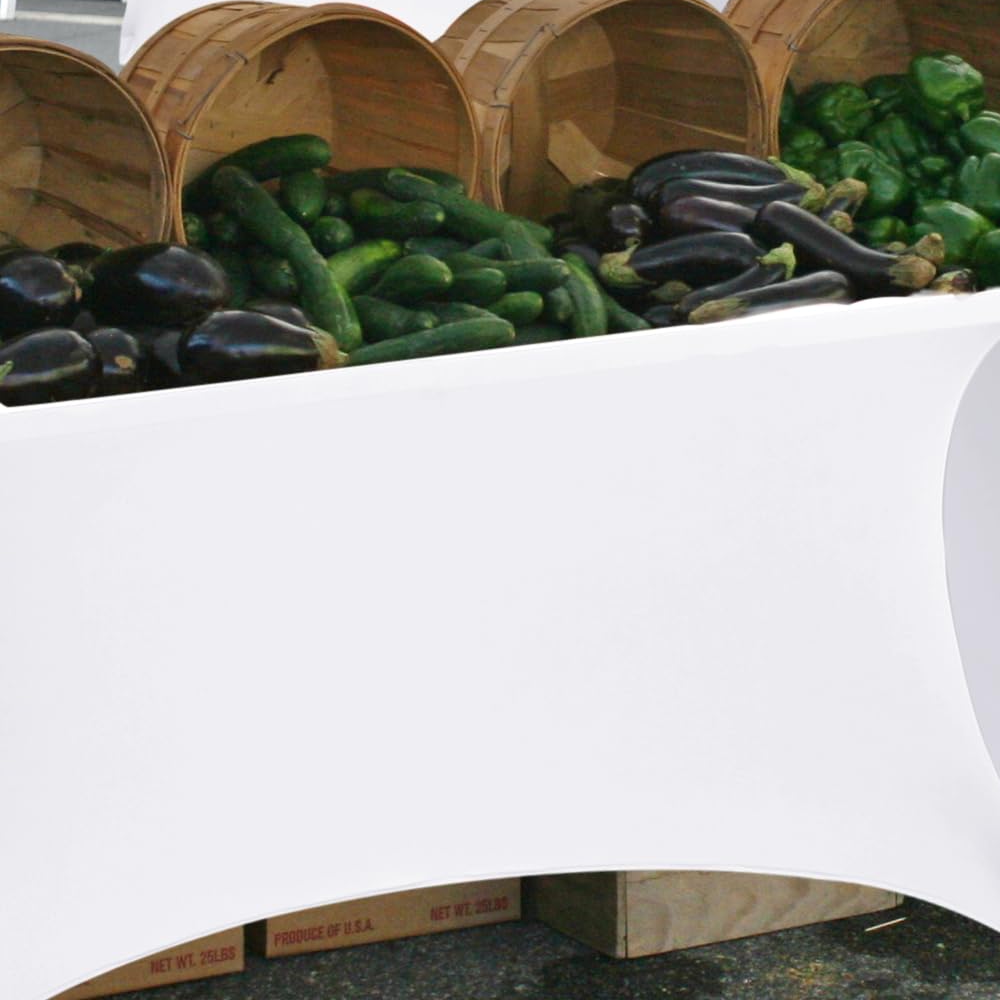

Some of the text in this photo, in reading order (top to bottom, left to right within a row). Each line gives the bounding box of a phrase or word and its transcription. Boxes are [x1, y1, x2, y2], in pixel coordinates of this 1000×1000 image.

[431, 904, 450, 921] NET
[273, 926, 324, 947] PRODUCE
[327, 922, 342, 938] OF
[150, 946, 237, 974] NET WT. 25LBS
